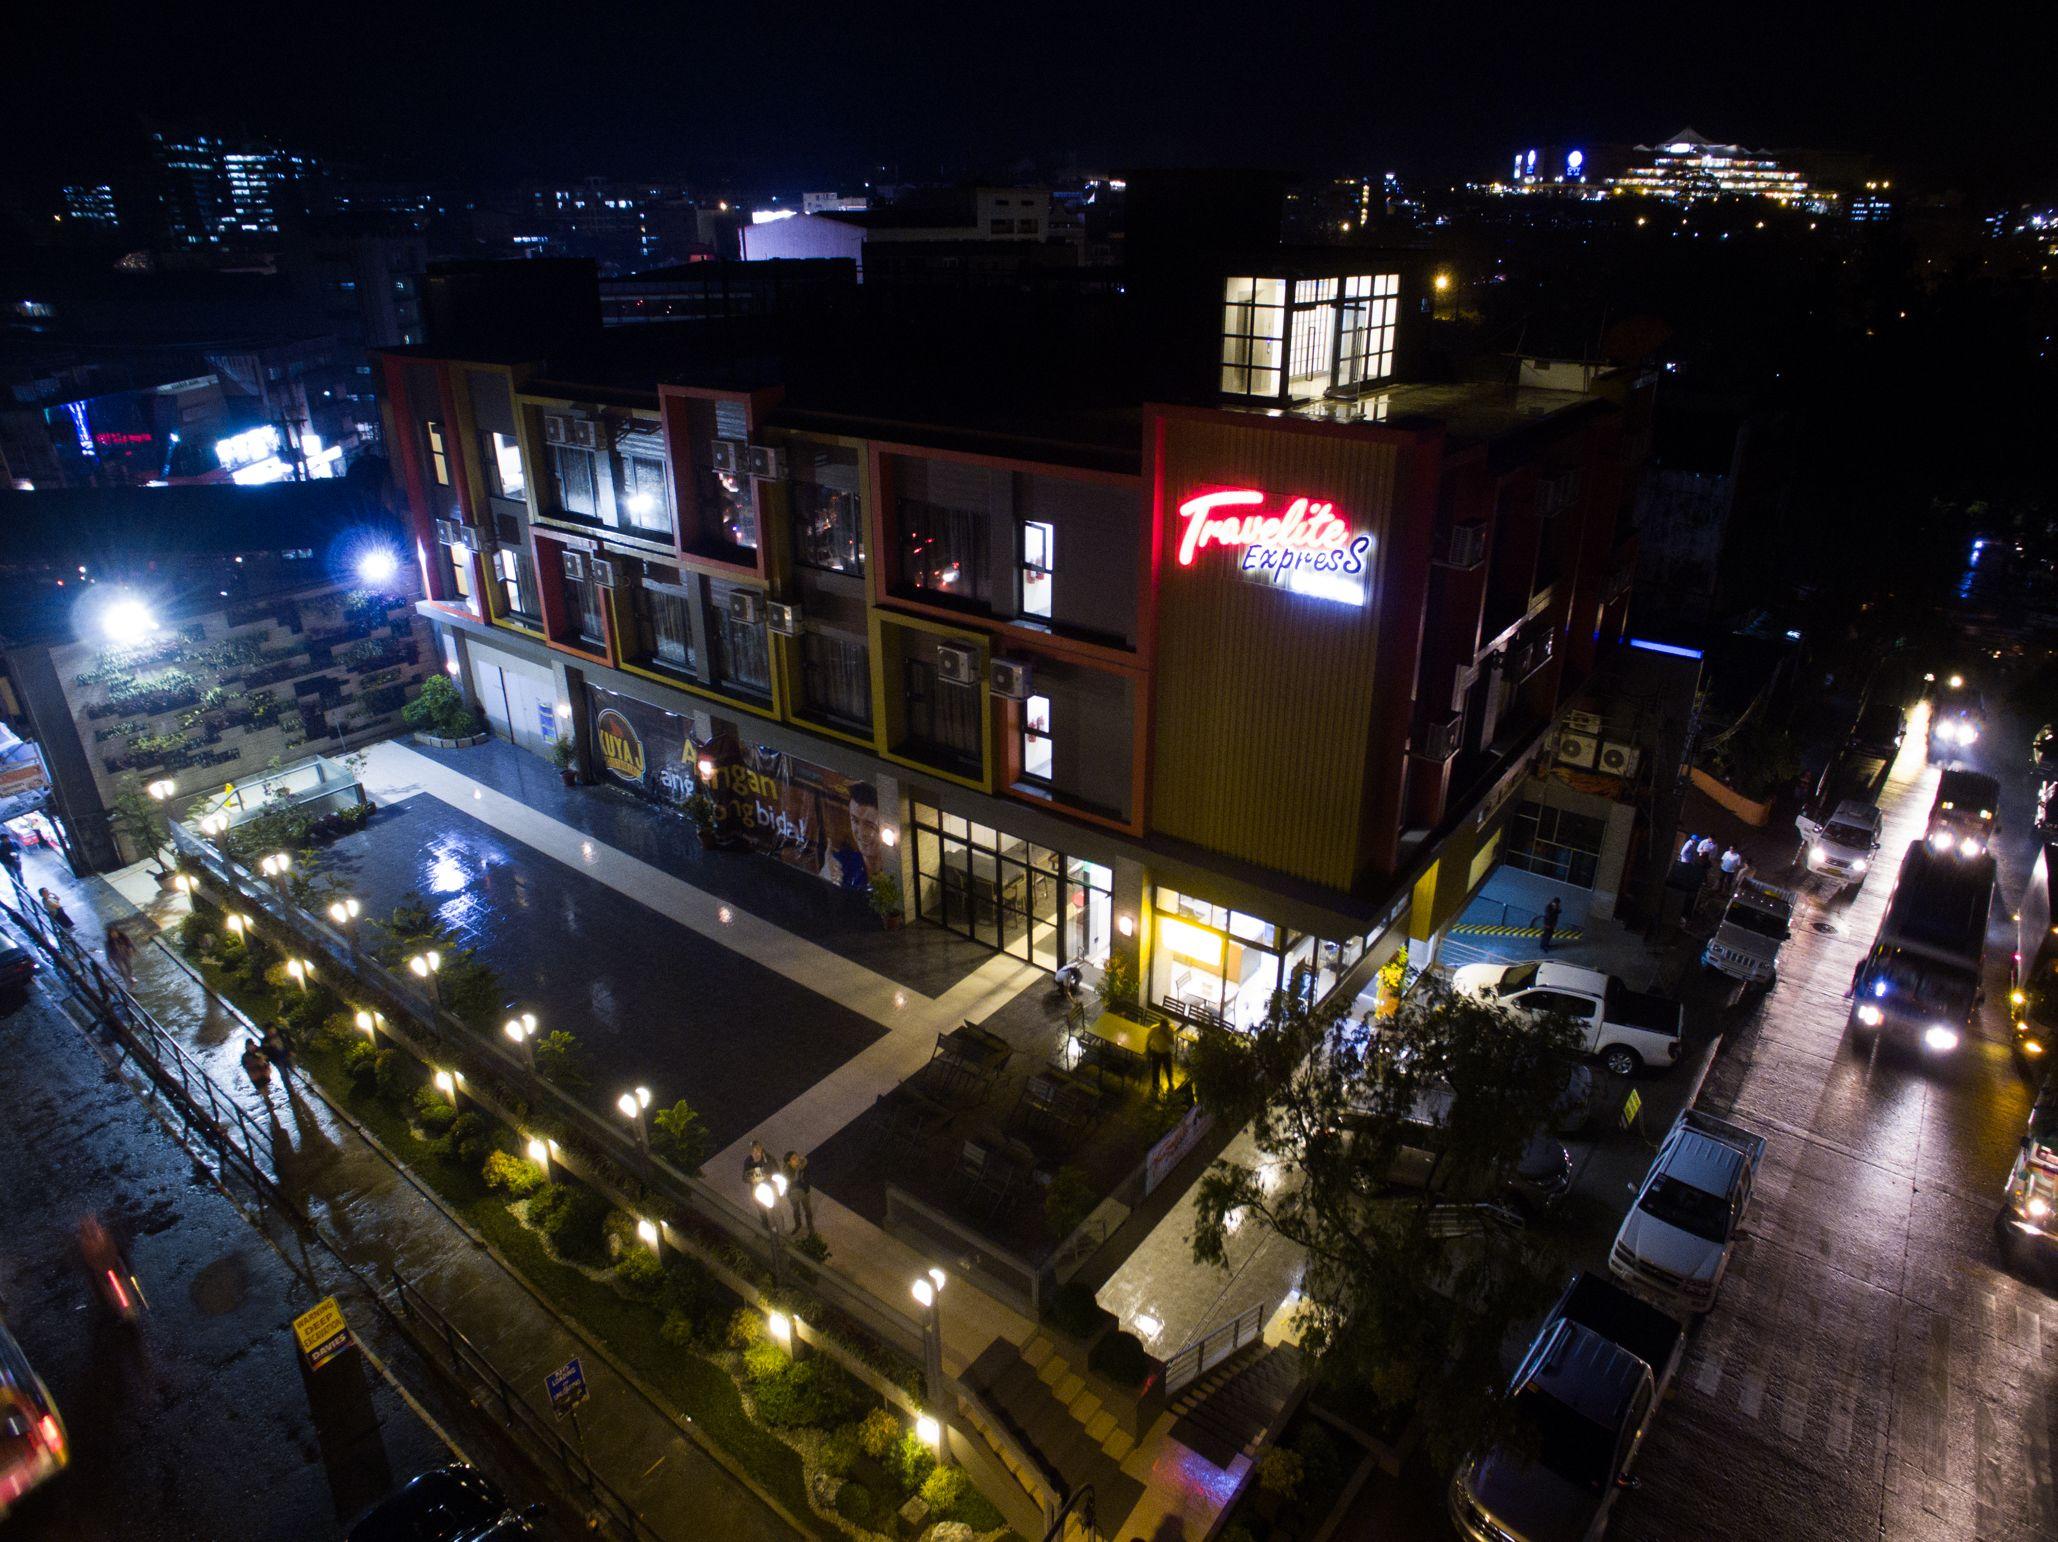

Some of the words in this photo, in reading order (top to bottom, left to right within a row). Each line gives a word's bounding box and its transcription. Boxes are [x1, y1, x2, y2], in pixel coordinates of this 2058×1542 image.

[1179, 491, 1349, 566] Travelite
[296, 1301, 334, 1328] WARNING
[304, 1312, 333, 1335] DEEP
[311, 1333, 347, 1360] DAVIES
